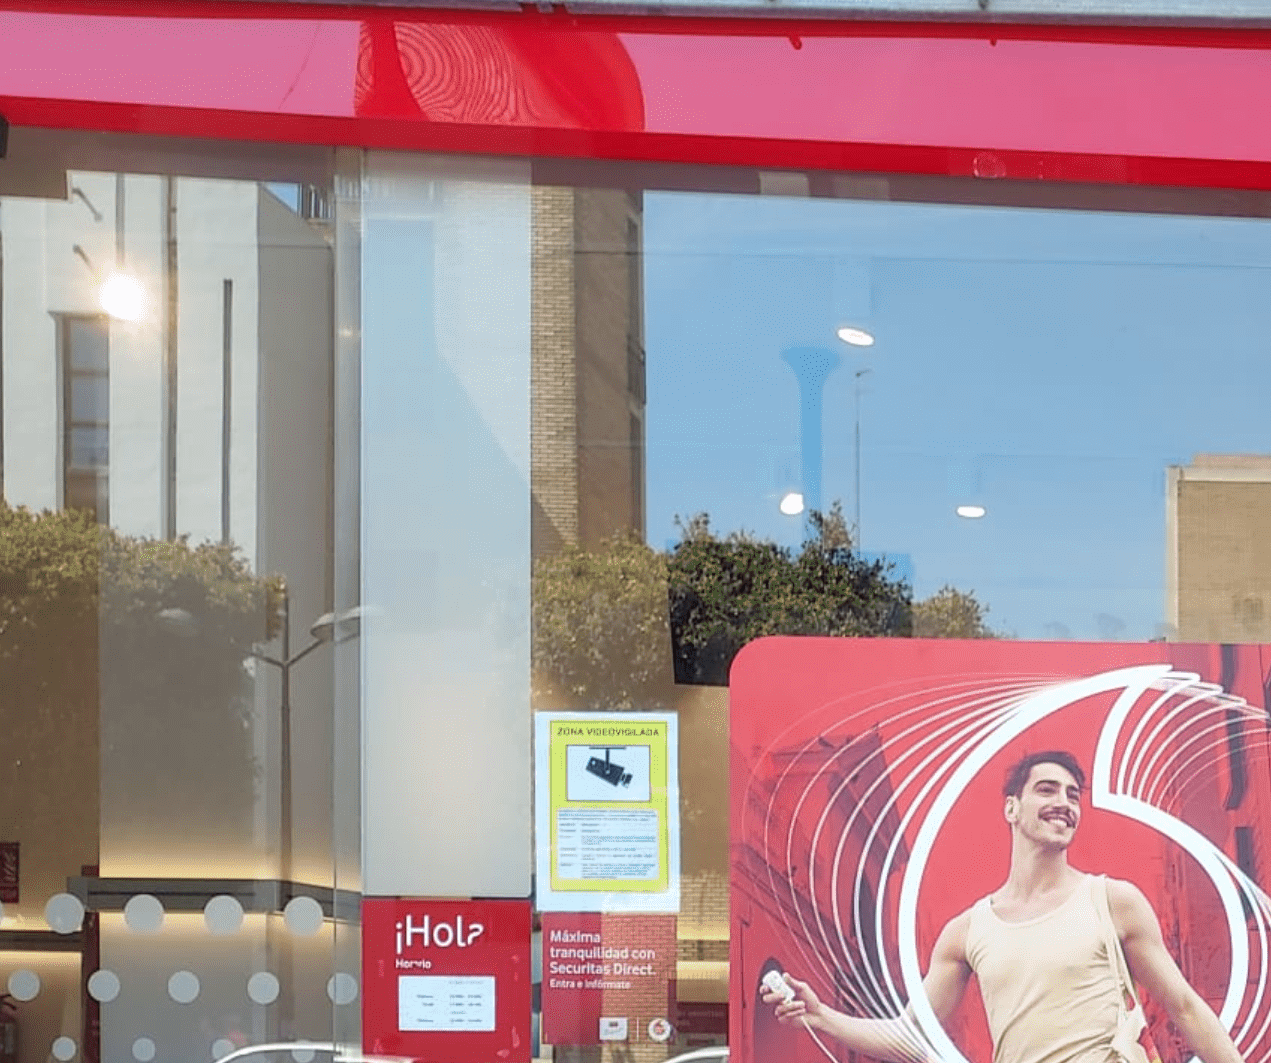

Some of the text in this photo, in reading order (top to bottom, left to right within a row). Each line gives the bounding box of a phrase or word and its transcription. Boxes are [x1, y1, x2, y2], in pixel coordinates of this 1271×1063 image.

[557, 727, 584, 737] ZONA
[550, 929, 601, 943] Máxima
[550, 946, 656, 961] tranquilidad con
[550, 961, 657, 976] Securitas Direct.
[550, 979, 576, 988] Entra
